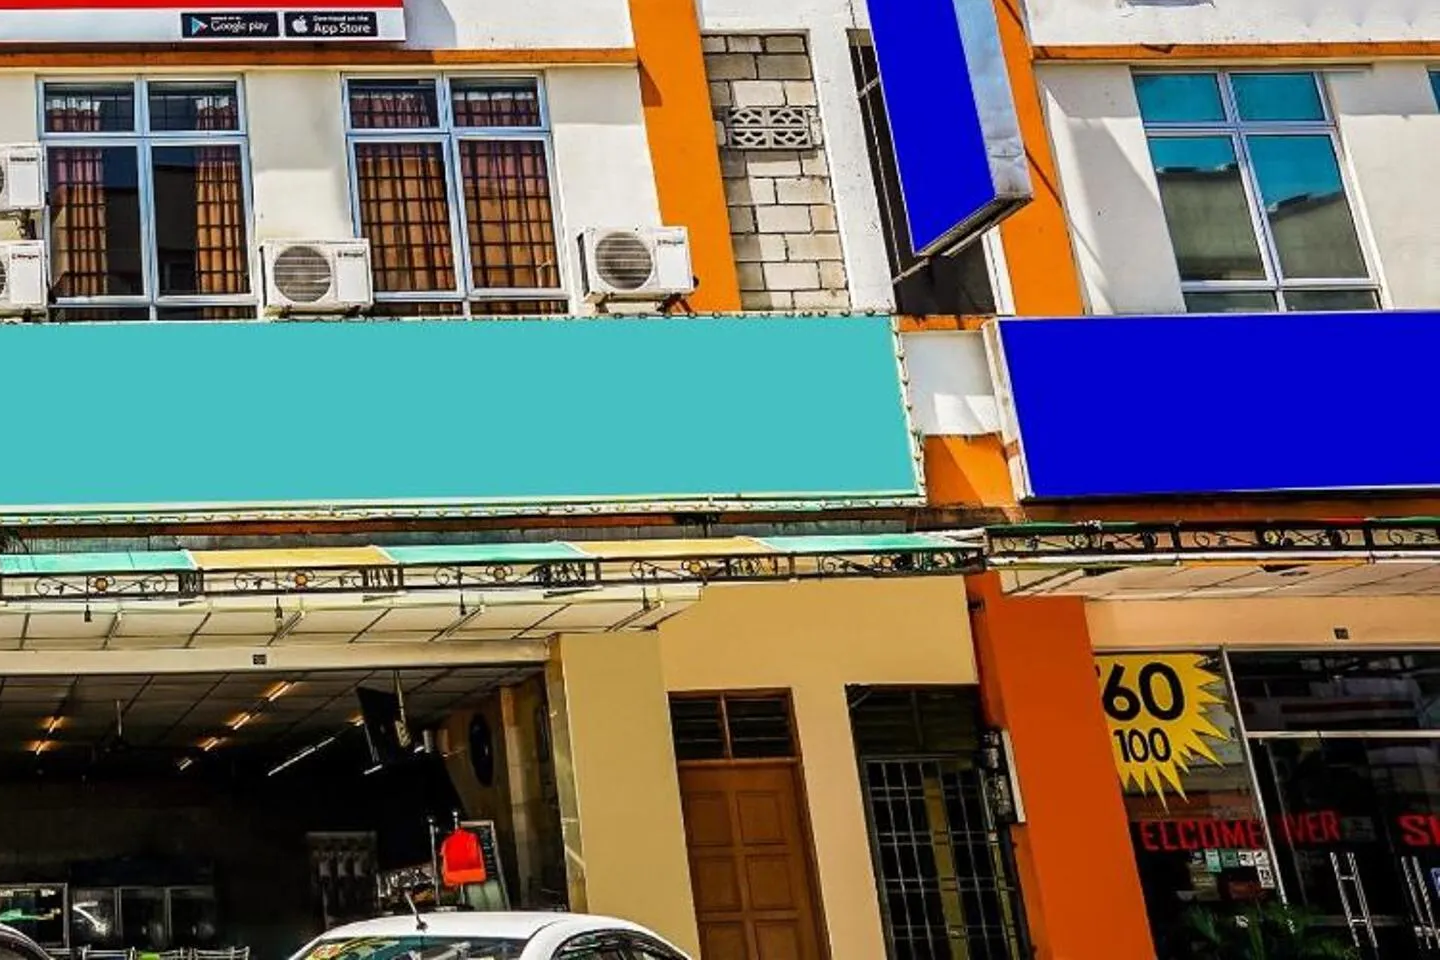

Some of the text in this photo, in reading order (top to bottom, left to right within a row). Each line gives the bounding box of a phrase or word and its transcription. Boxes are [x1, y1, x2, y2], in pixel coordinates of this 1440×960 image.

[211, 20, 246, 34] Google
[313, 22, 371, 35] App Store
[1113, 727, 1171, 763] 100
